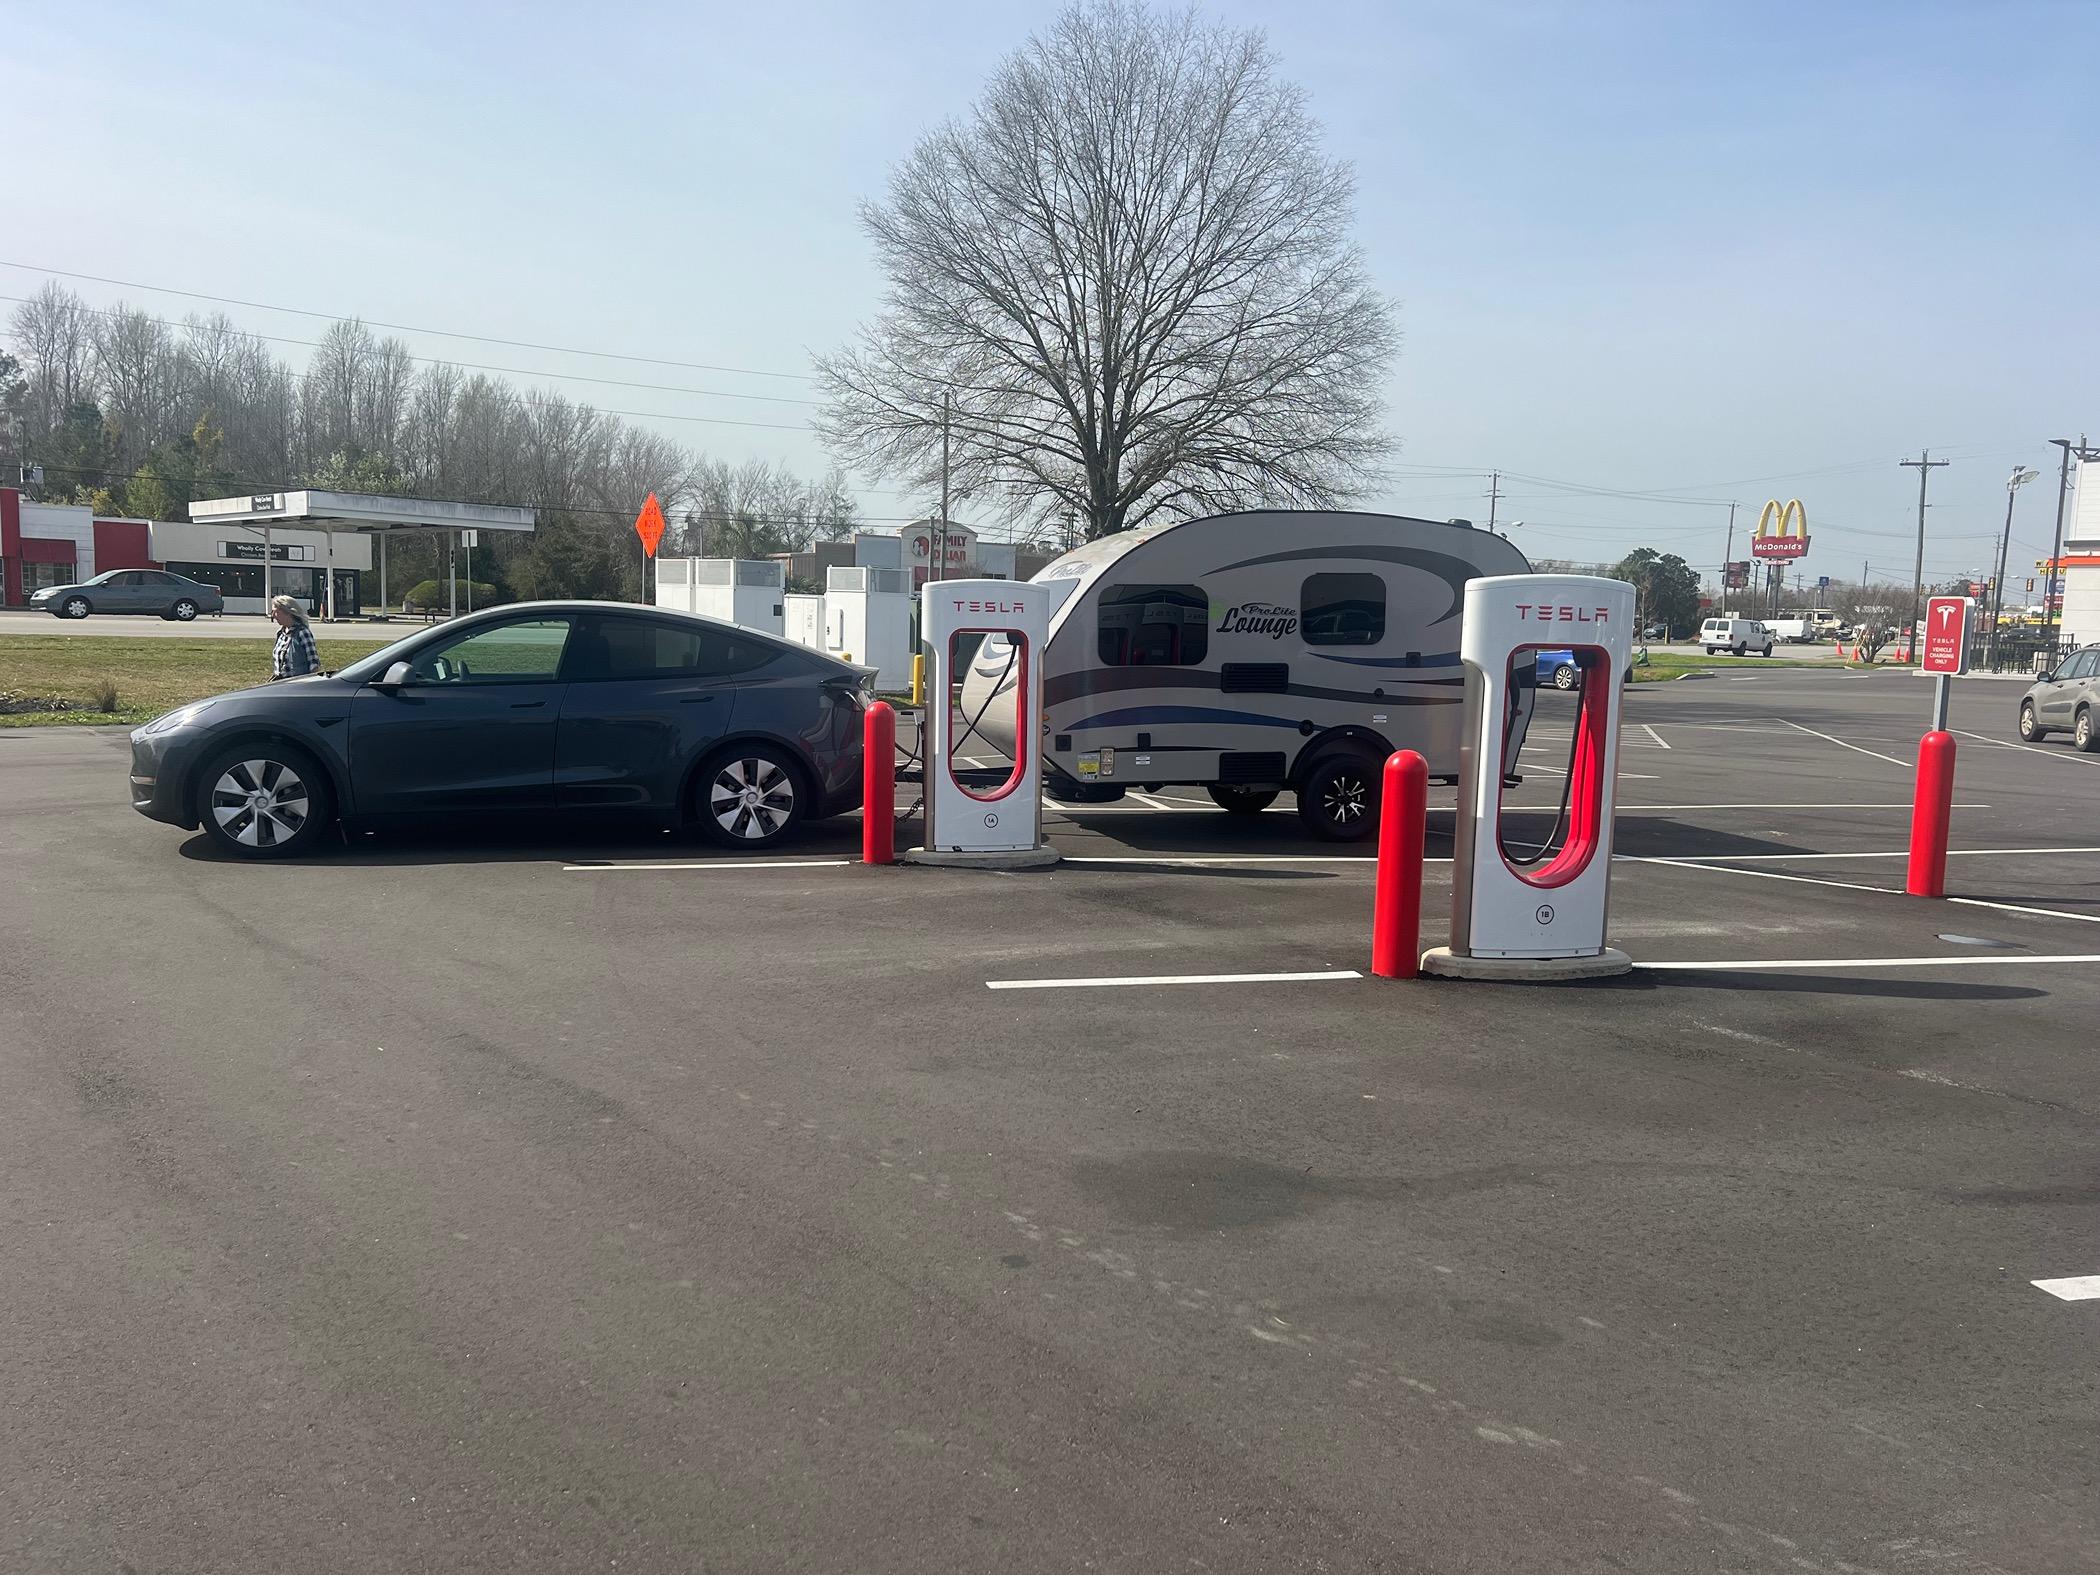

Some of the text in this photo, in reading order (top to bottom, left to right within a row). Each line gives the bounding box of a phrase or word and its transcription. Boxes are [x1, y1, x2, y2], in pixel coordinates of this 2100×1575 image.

[1755, 543, 1802, 551] McDonald's
[953, 601, 1024, 613] TESLA
[1248, 605, 1298, 616] ProLite
[1515, 605, 1608, 622] TESLA
[1216, 607, 1298, 640] Lounge
